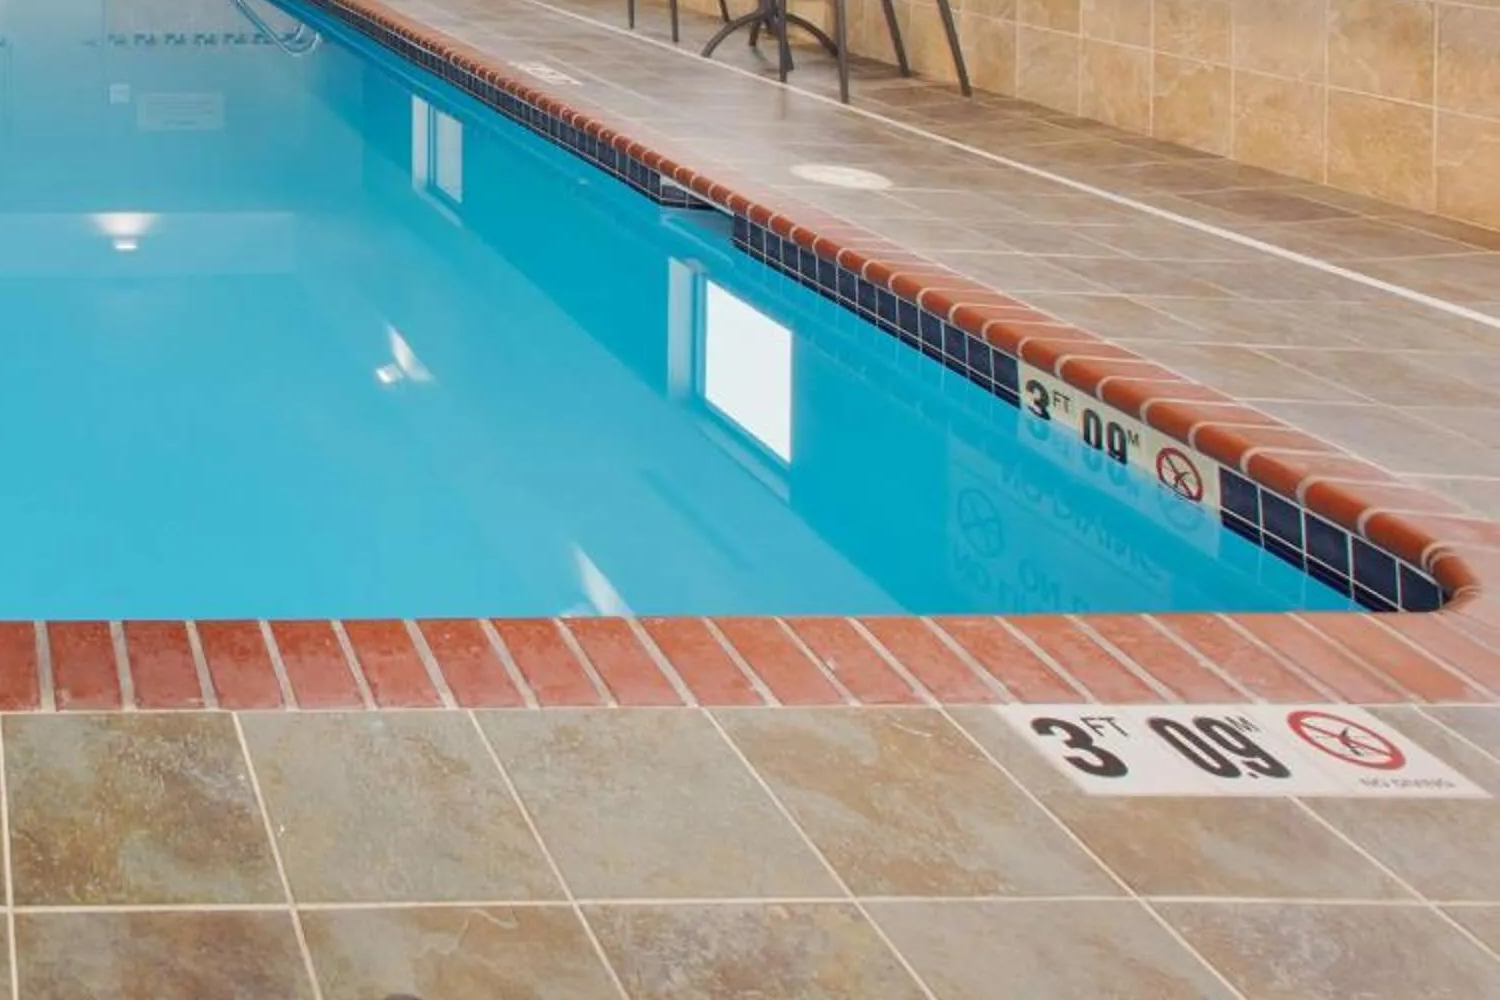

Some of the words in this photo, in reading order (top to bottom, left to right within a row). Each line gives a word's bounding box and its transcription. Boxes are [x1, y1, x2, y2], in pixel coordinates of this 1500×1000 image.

[1026, 379, 1051, 421] 3
[1052, 389, 1071, 414] FT
[1127, 429, 1139, 447] M
[1079, 716, 1129, 738] FT
[1223, 715, 1263, 734] M
[1030, 717, 1129, 778] 3
